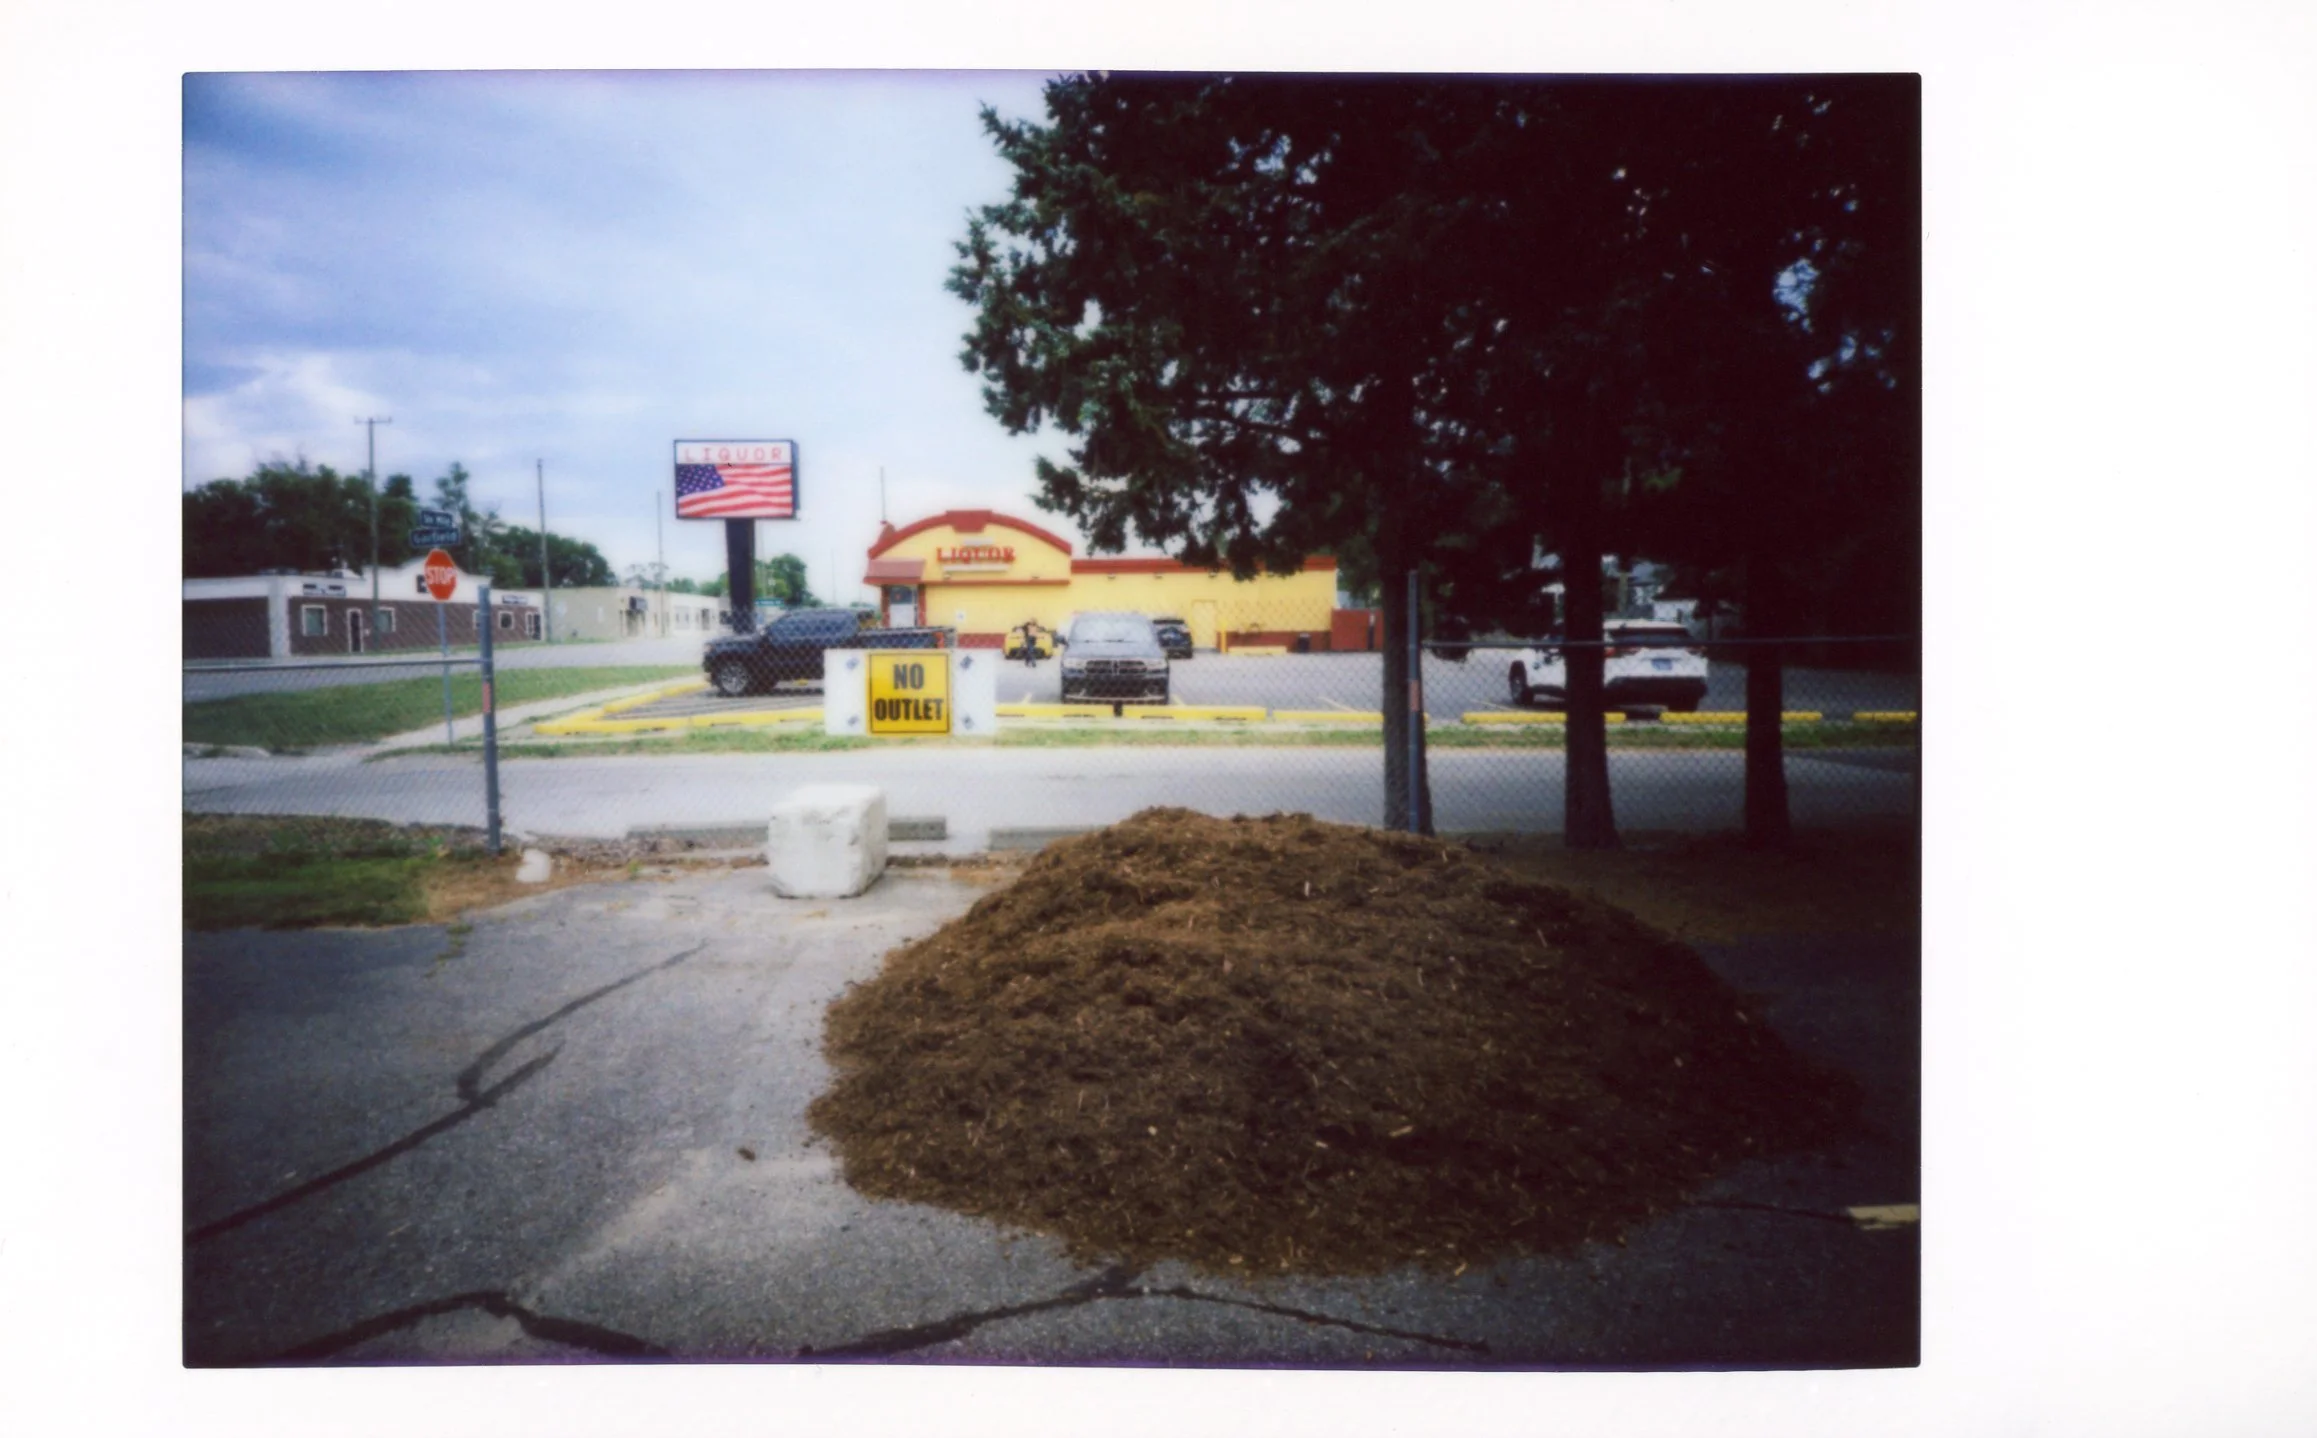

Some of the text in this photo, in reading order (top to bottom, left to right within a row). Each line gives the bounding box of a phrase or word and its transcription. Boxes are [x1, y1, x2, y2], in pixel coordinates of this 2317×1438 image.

[684, 447, 783, 462] LIQUOR
[936, 547, 1016, 565] LIQUOR
[426, 566, 457, 585] STOP
[893, 663, 924, 690] NO
[874, 698, 944, 721] OUTLET
